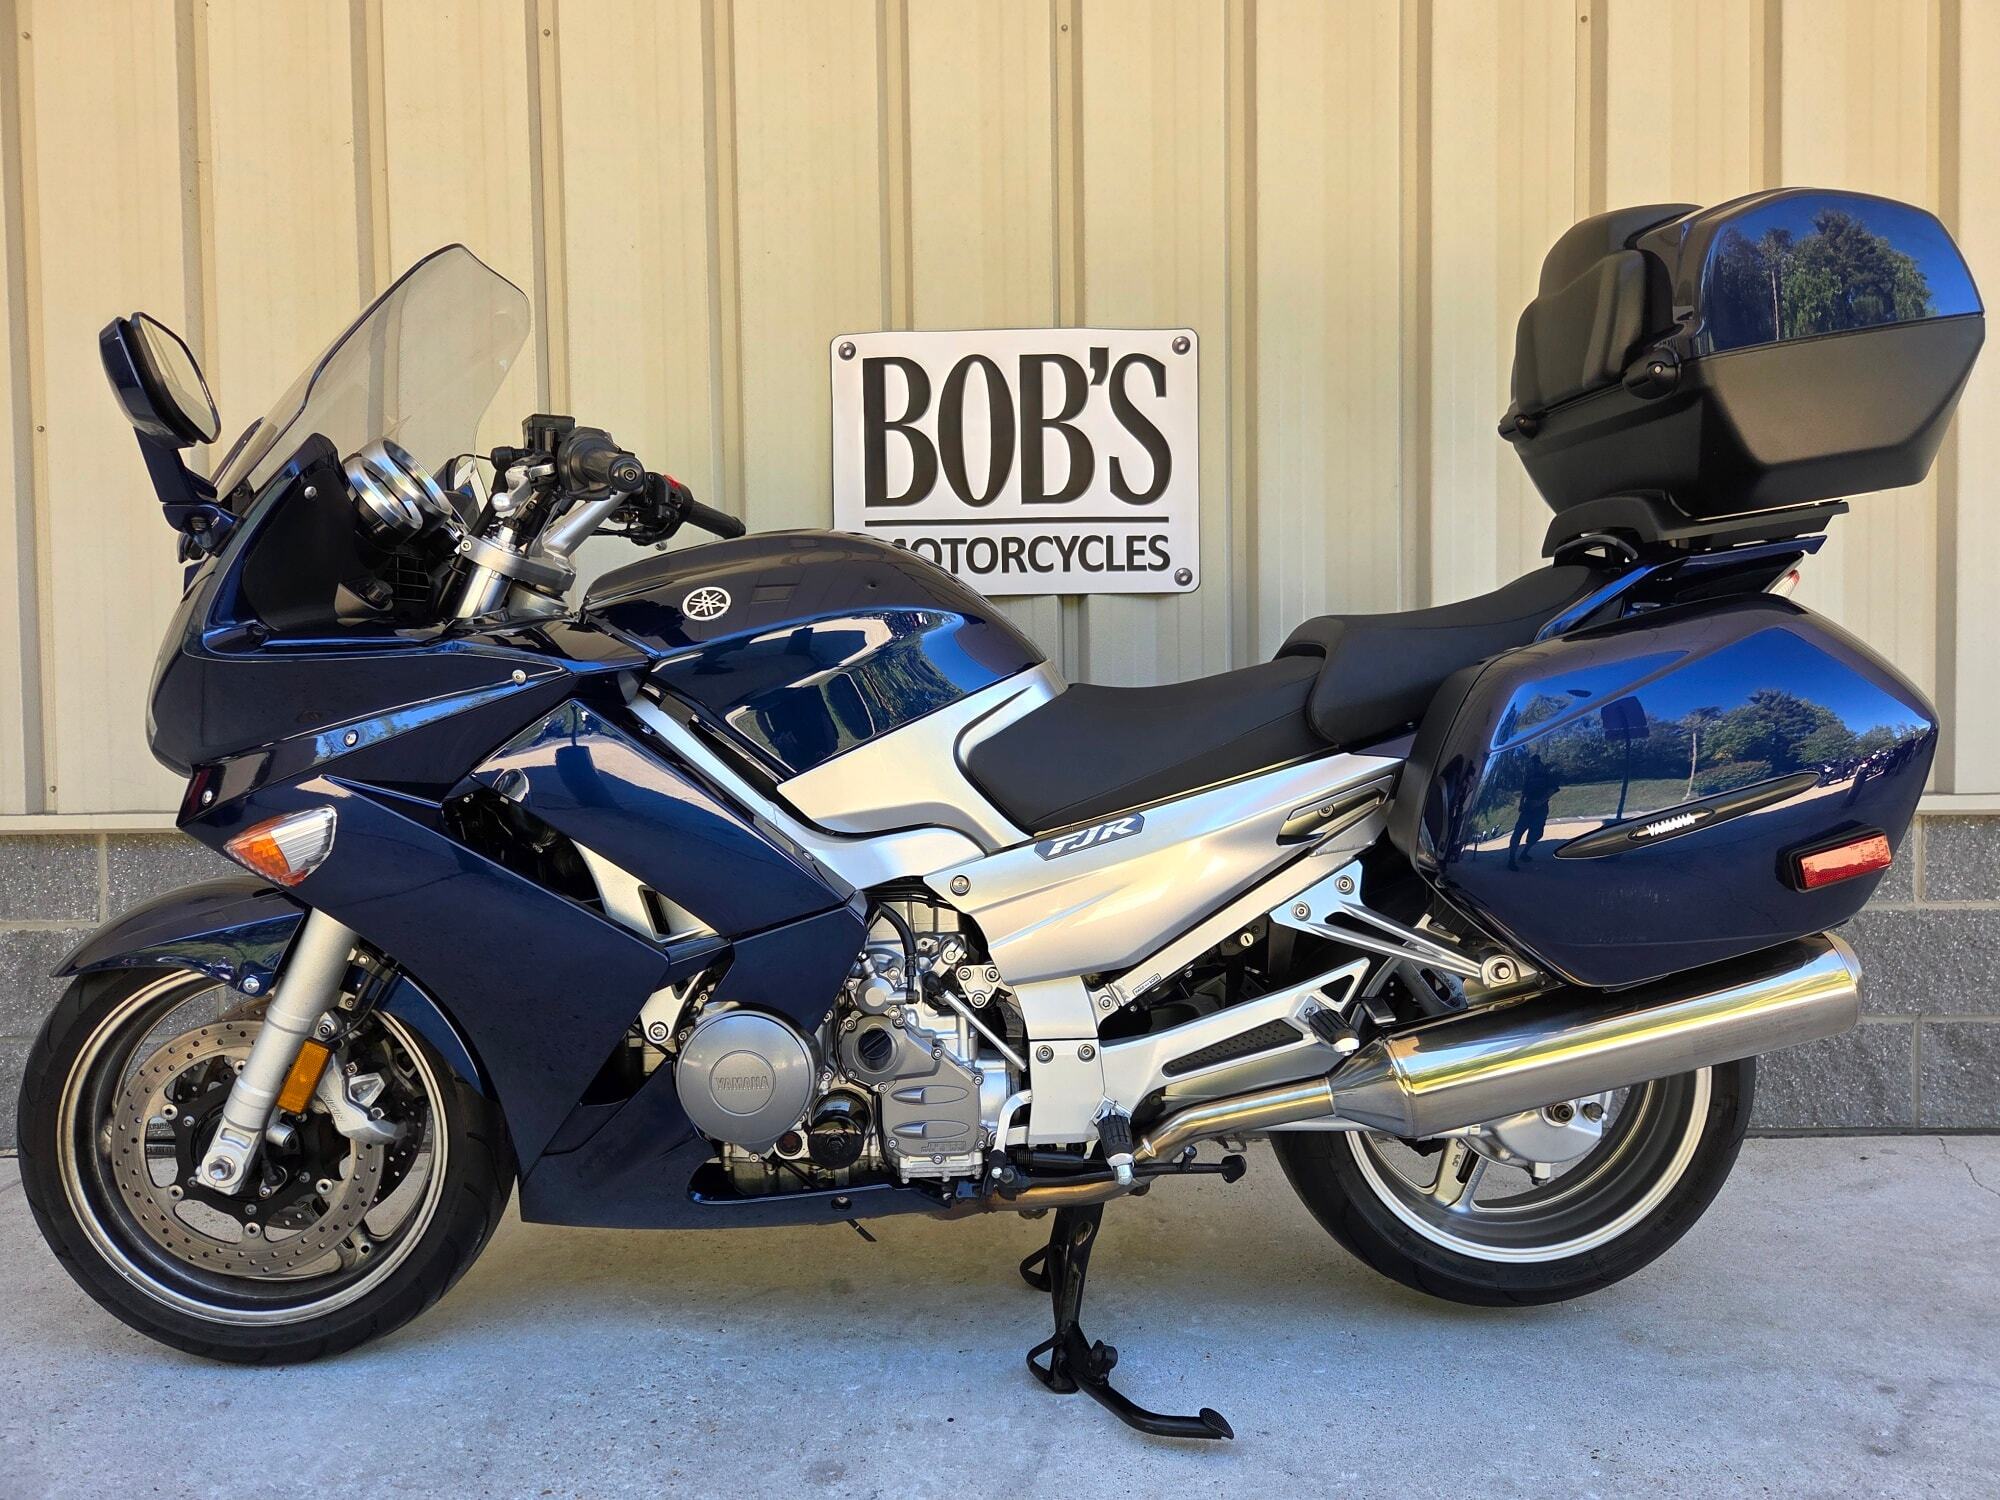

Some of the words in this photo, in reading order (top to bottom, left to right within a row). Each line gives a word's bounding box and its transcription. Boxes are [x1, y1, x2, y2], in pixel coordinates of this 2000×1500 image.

[862, 347, 1172, 508] BOB'S
[891, 535, 1171, 574] OTORCYCLES
[1047, 817, 1137, 857] FJR
[1646, 813, 1696, 837] YAMAHA
[715, 1075, 769, 1091] YAMAHA
